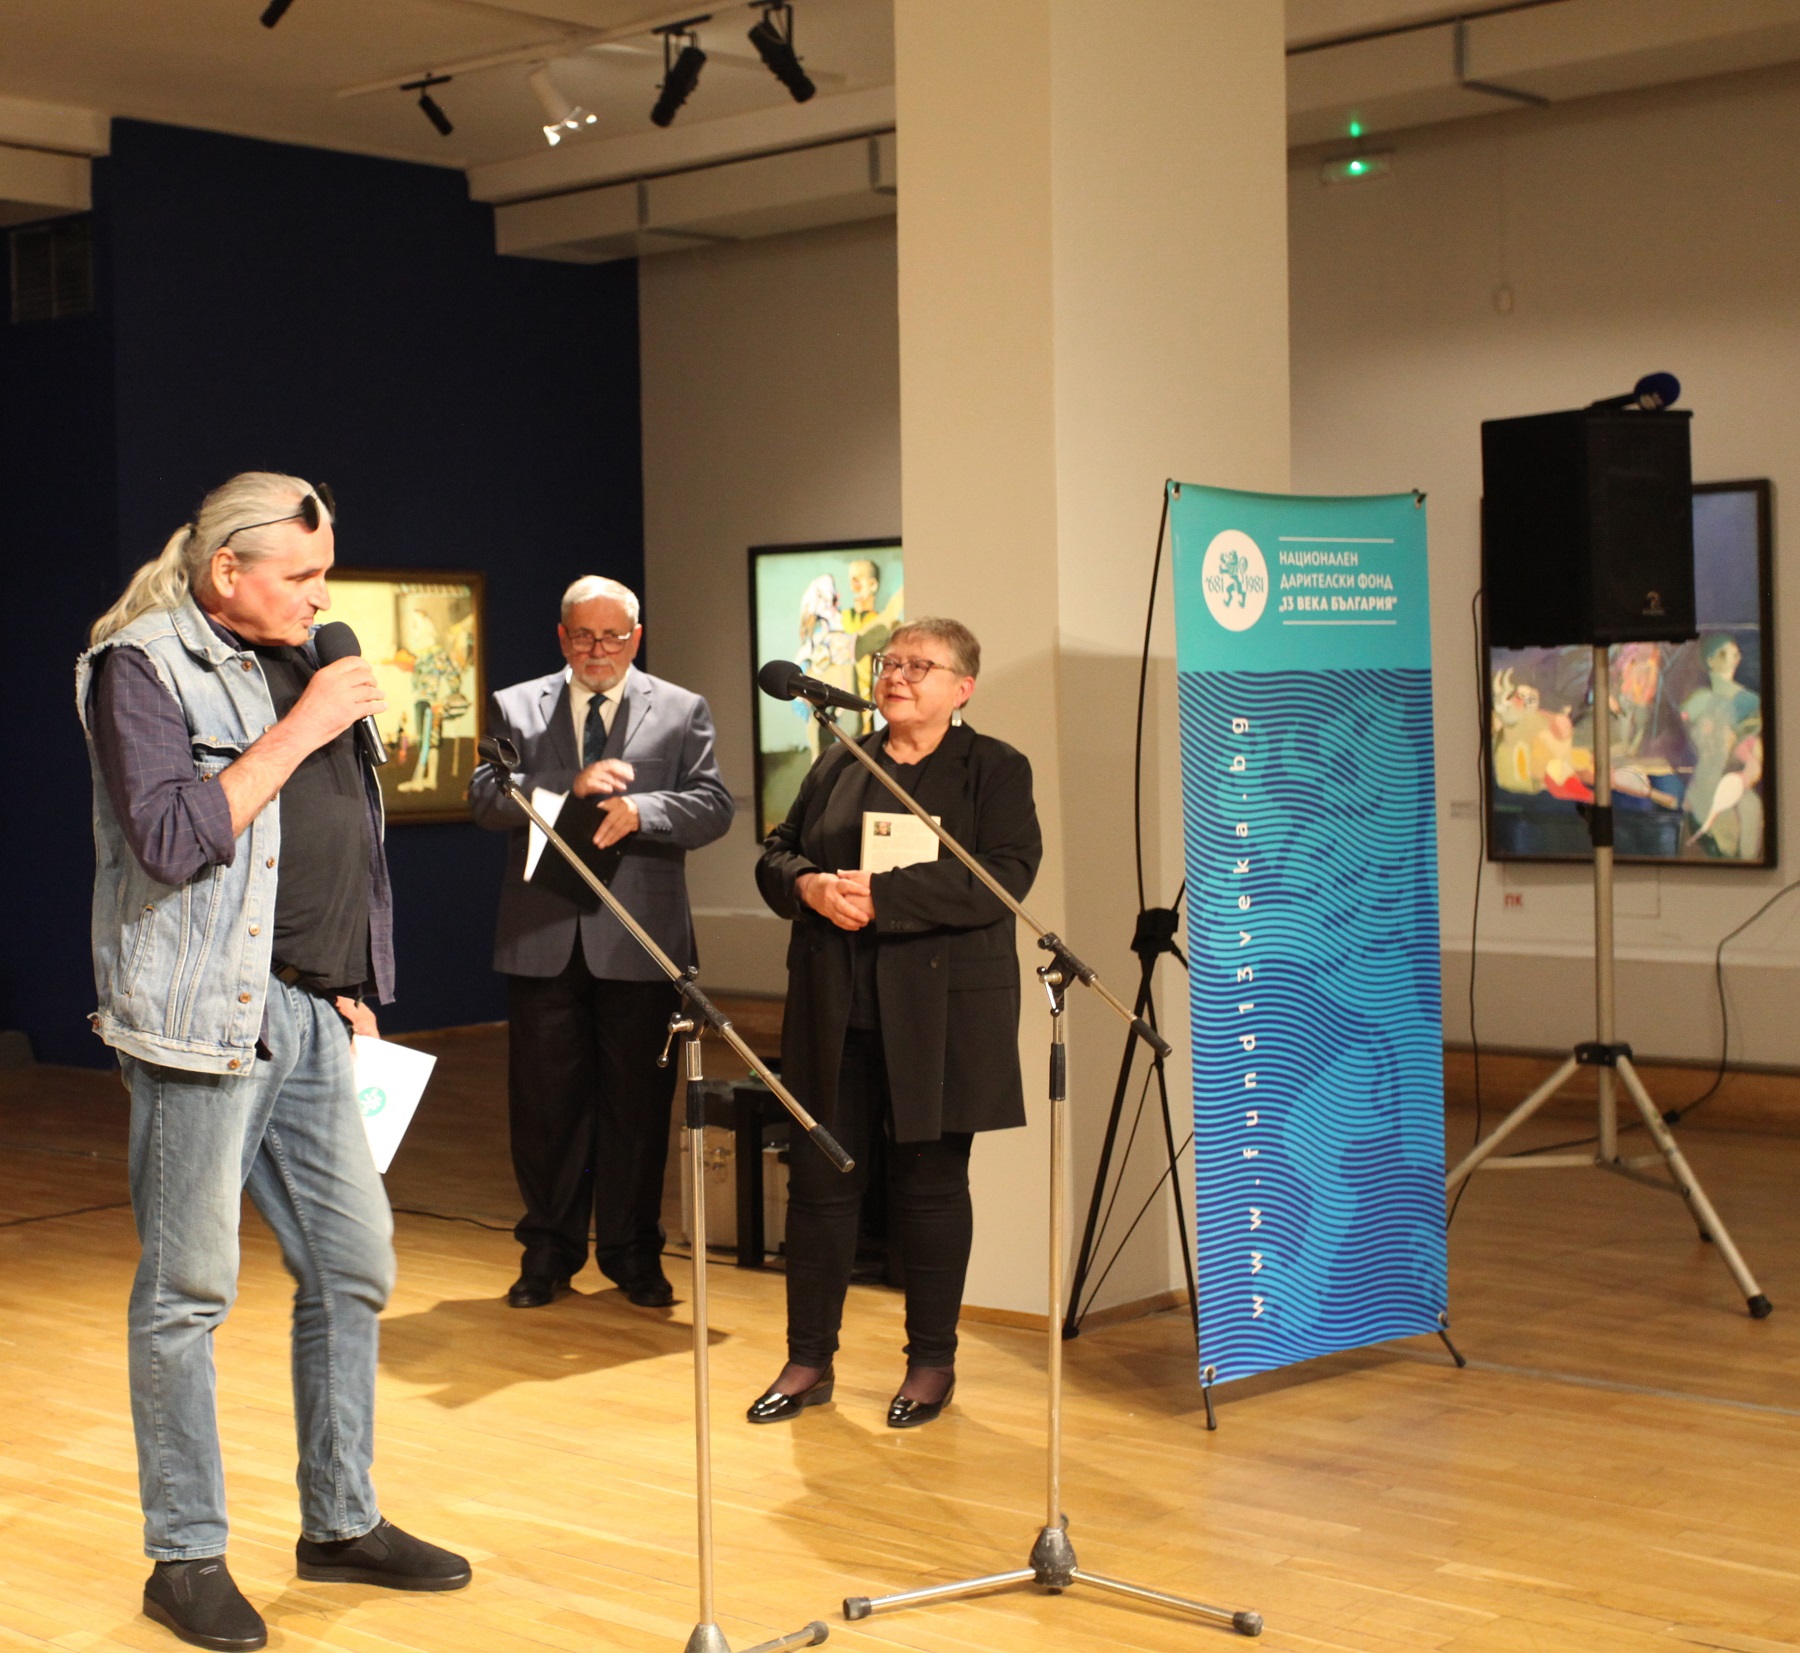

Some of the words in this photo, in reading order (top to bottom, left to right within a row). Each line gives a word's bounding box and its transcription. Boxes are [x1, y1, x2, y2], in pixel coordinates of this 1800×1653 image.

[1279, 551, 1358, 568] НАЦИОНАЛЕН
[1245, 575, 1264, 593] 1981
[1280, 573, 1355, 590] ДАРИТЕЛСКИ
[1357, 572, 1393, 591] ФОНД
[1297, 596, 1328, 611] ВЕКА
